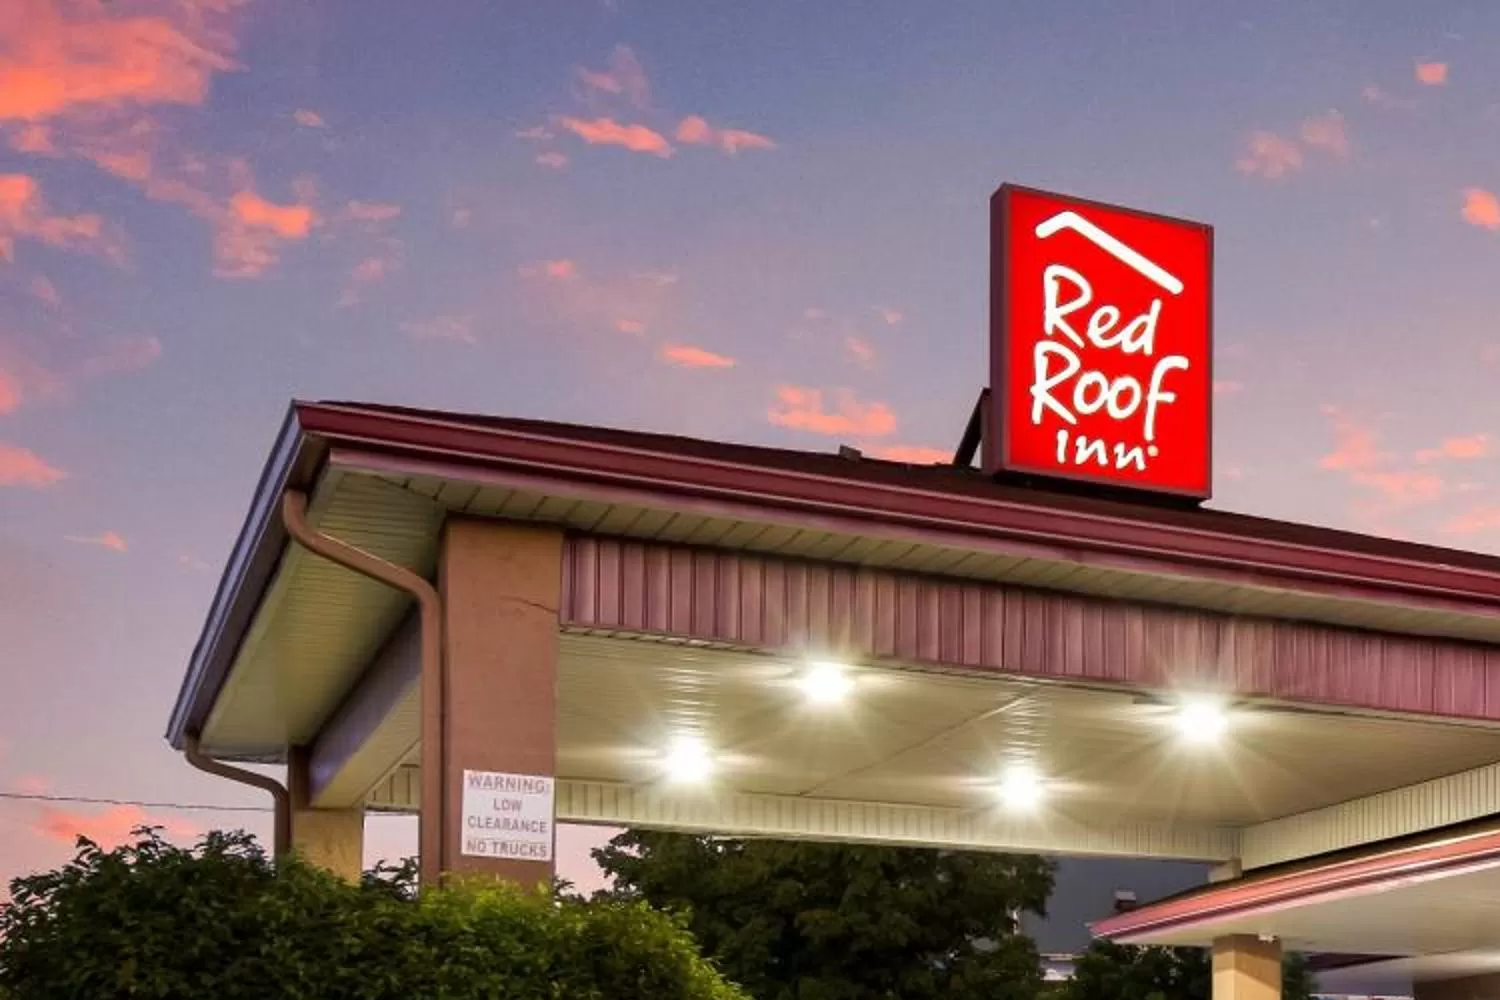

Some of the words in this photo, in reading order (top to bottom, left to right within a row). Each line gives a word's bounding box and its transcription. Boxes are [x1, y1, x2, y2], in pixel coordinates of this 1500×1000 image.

[1043, 264, 1162, 355] Red
[1029, 340, 1189, 442] Roof
[493, 798, 522, 812] LOW
[467, 816, 548, 833] CLEARANCE
[466, 840, 487, 854] NO
[492, 841, 547, 857] TRUCKS
